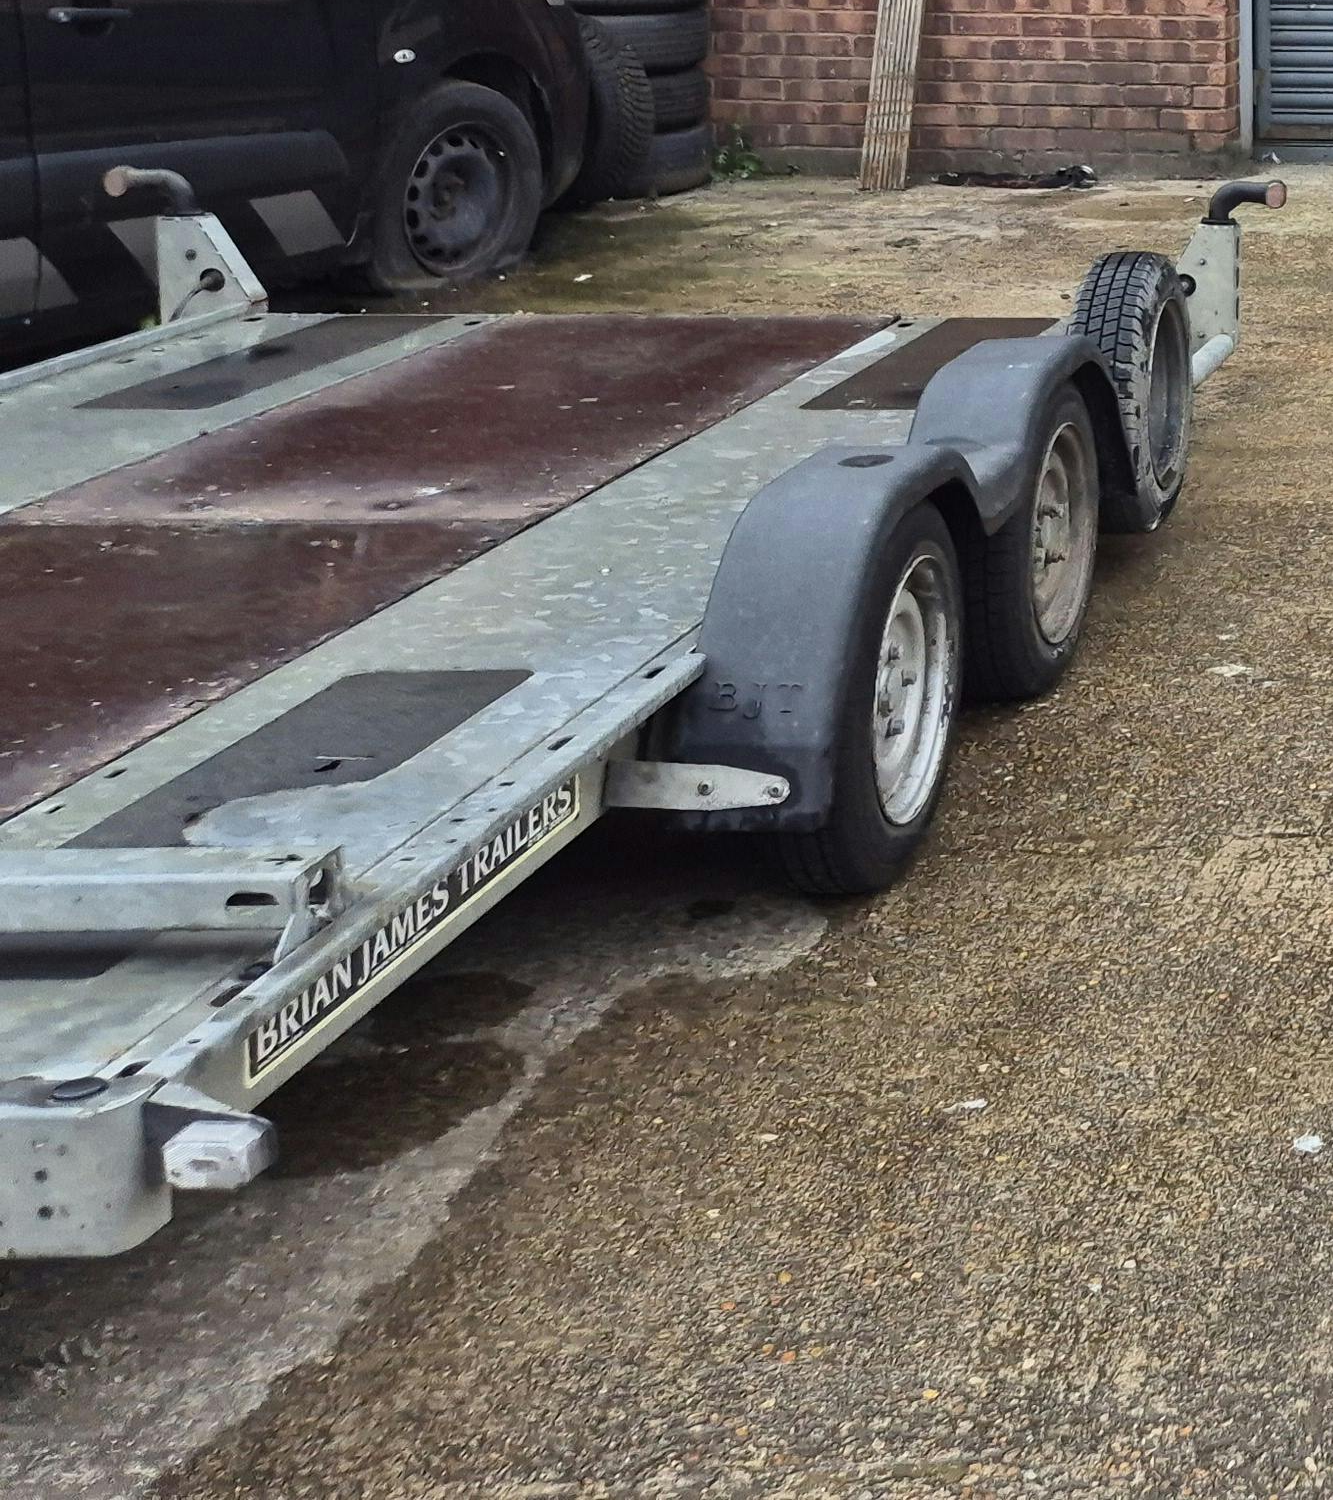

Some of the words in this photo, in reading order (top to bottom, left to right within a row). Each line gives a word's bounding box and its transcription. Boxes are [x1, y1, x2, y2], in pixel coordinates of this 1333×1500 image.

[708, 681, 803, 719] BJT
[256, 956, 352, 1063] BRIAN
[359, 879, 451, 986] JAMES
[456, 783, 572, 896] TRAILERS
